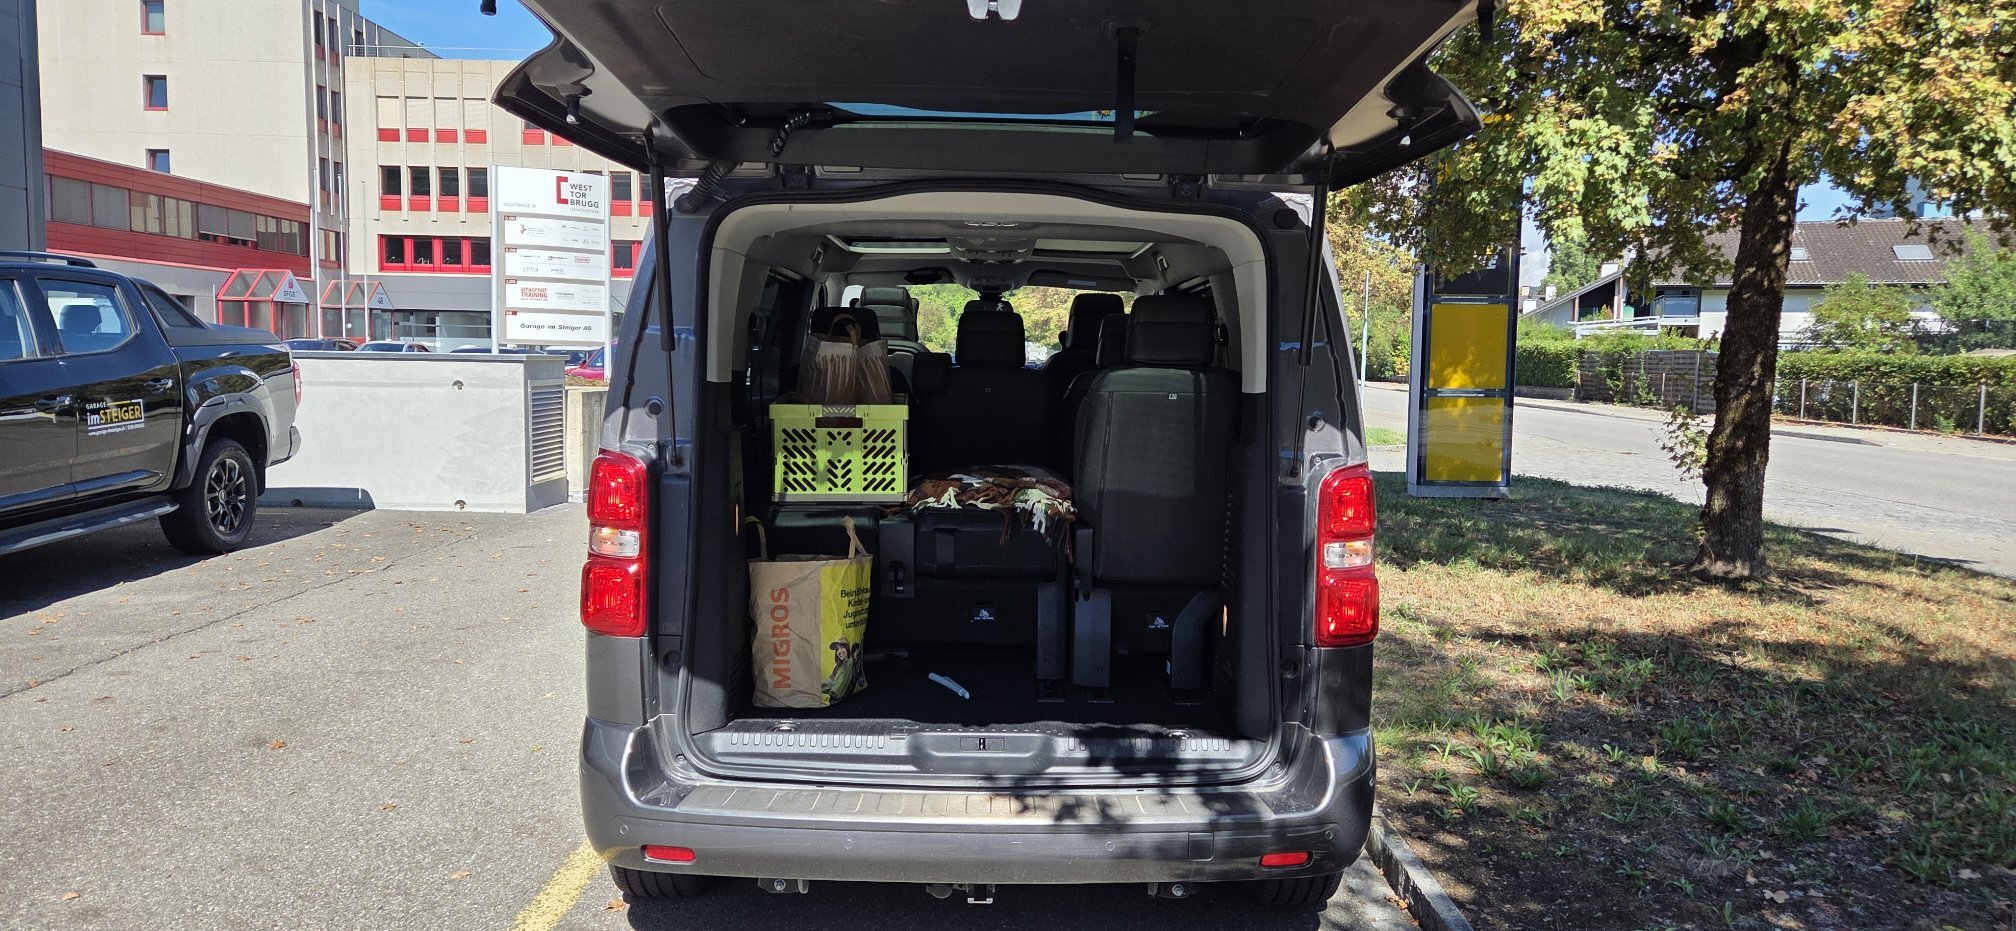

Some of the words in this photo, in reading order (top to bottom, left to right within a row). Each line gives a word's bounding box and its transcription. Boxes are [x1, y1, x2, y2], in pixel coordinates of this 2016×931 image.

[570, 183, 592, 192] WEST
[570, 191, 587, 199] TOR
[570, 199, 599, 208] BRUGG
[558, 324, 581, 332] Steiger
[85, 401, 107, 410] GARAGE
[770, 586, 792, 690] MIGROS
